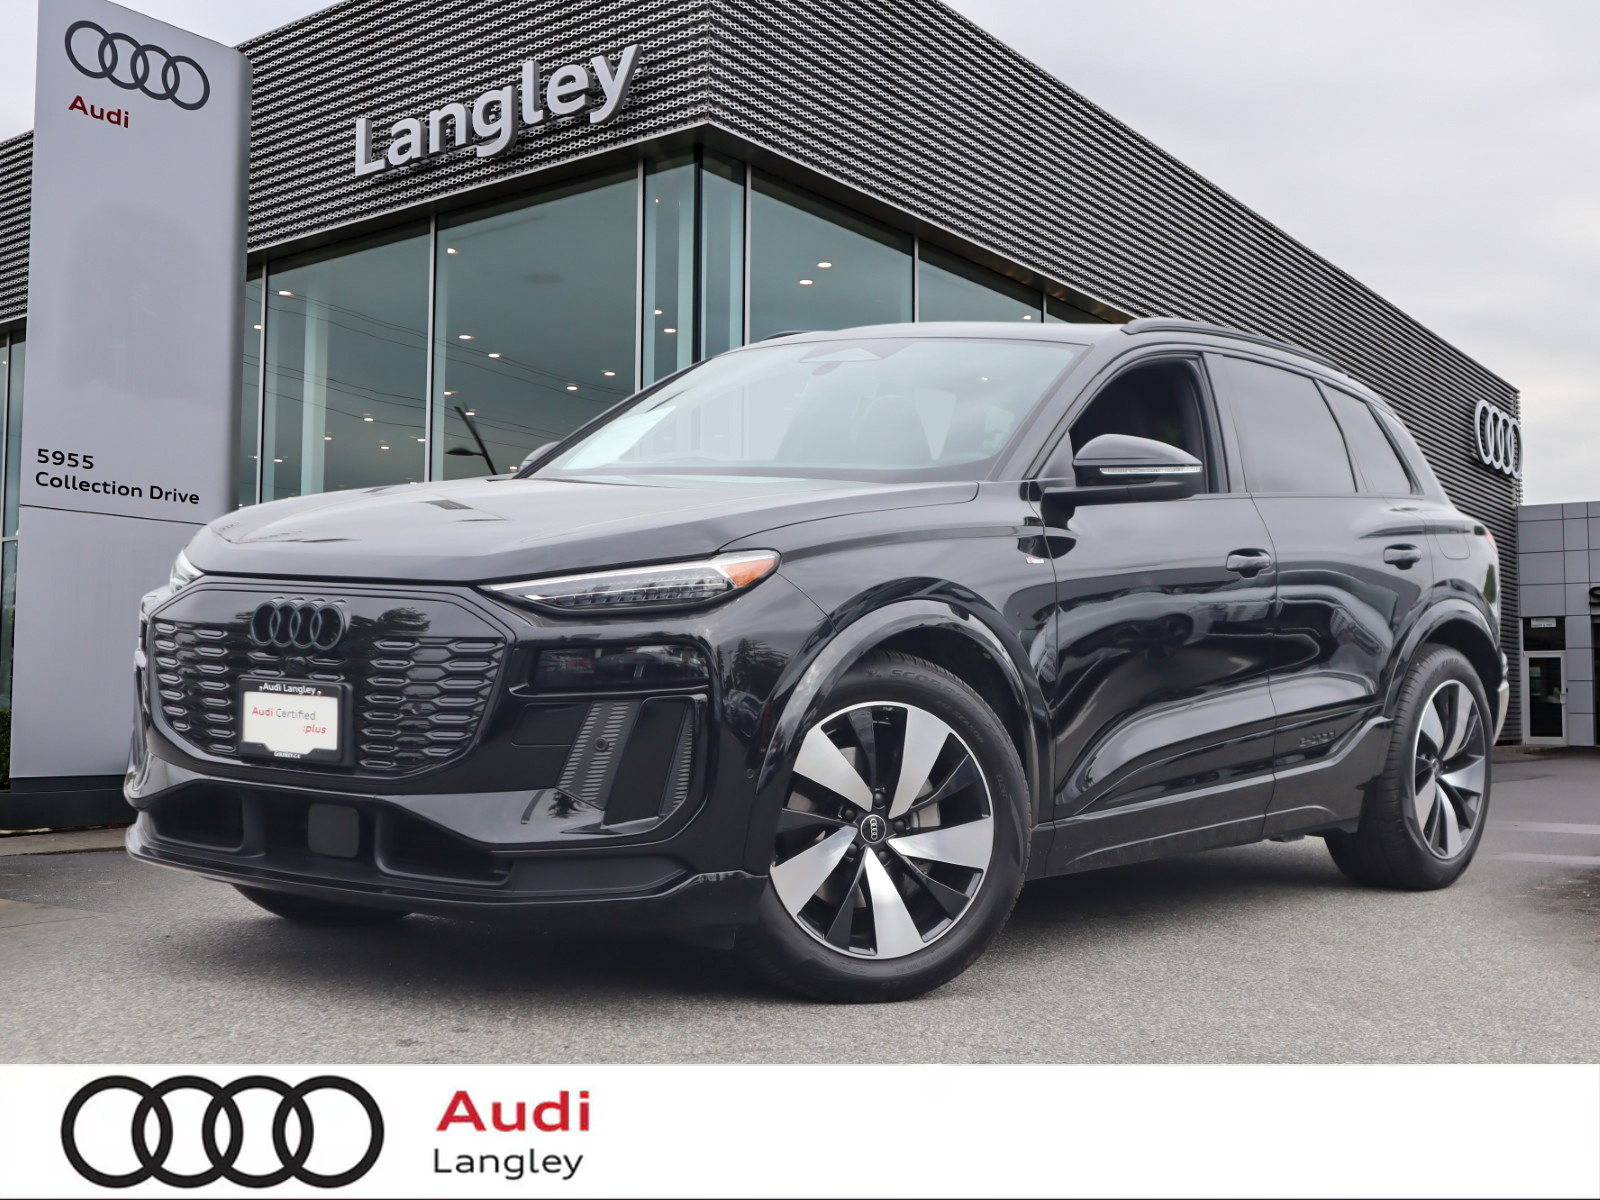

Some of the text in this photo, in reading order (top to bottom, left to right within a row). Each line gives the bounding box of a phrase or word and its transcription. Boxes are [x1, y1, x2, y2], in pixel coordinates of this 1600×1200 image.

[68, 95, 130, 129] Audi
[354, 44, 642, 177] Langley
[36, 448, 95, 470] 5955
[35, 471, 200, 505] Collection Drive
[262, 682, 316, 695] Audi Langley
[252, 706, 316, 720] Audi Certified
